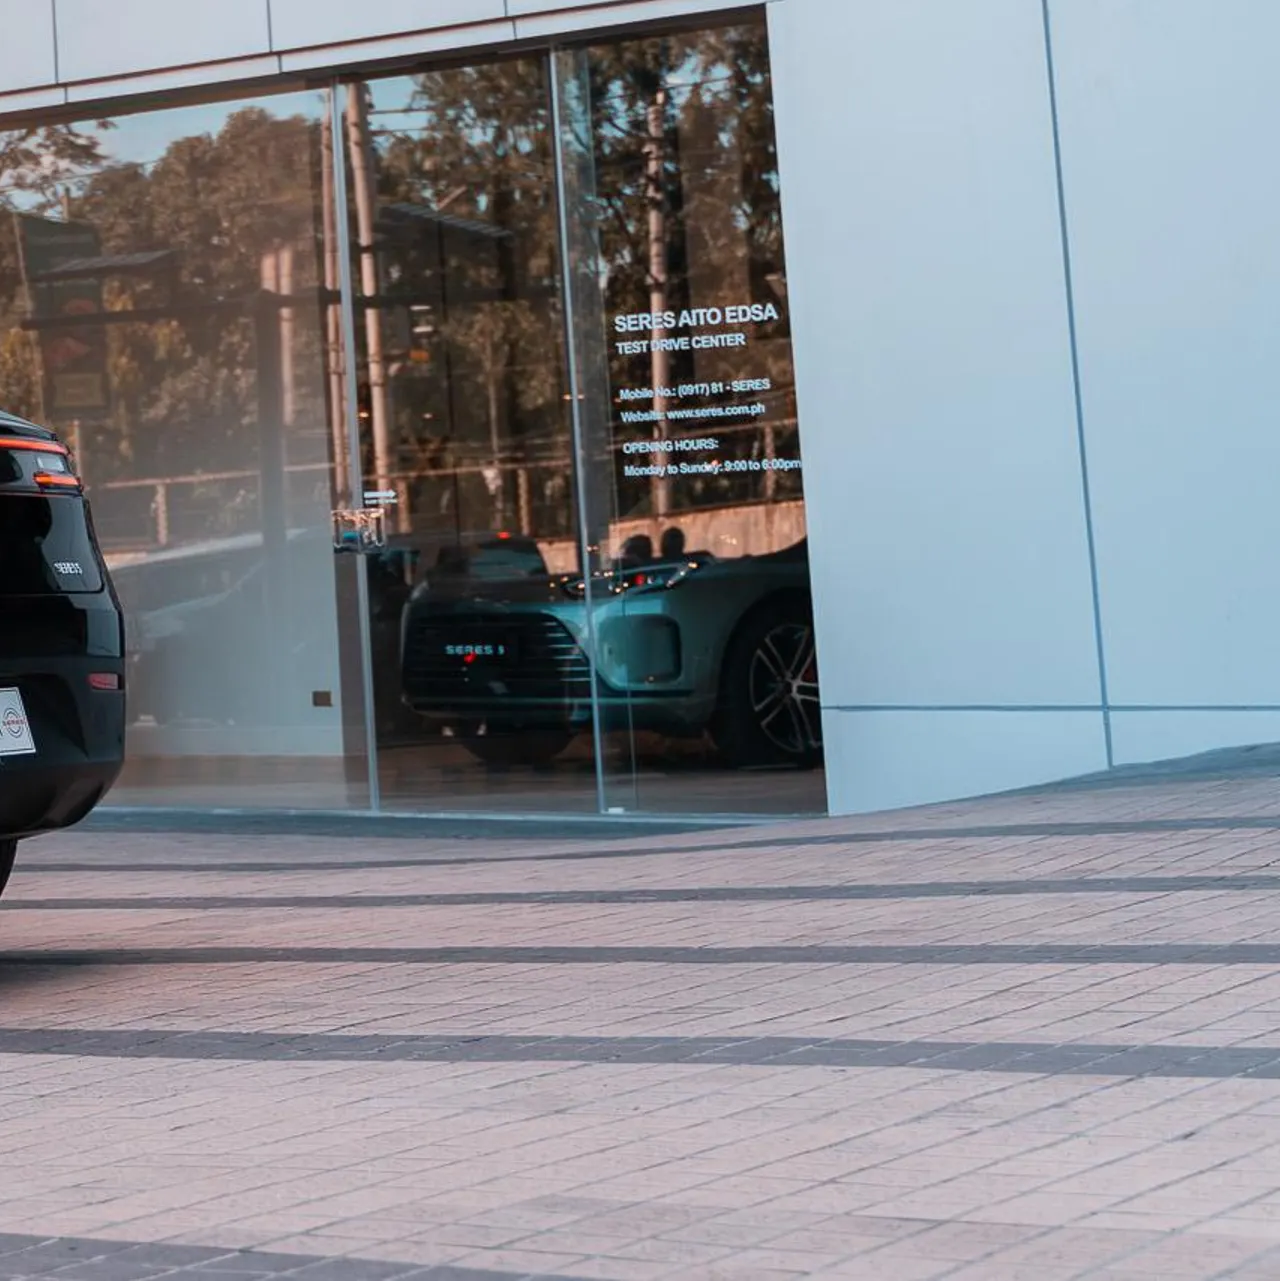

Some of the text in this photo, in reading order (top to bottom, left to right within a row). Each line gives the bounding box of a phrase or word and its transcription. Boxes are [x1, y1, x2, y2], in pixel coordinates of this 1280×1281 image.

[614, 303, 779, 333] SERES AITO EDSA
[615, 332, 746, 355] TEST DRIVE CENTER
[619, 386, 653, 400] Mobile
[655, 385, 676, 398] No.:
[678, 382, 710, 398] (0917)
[711, 382, 724, 394] 81
[732, 378, 771, 391] SERES
[667, 402, 766, 420] www.seres.com.ph
[623, 437, 719, 454] OPENING HOURS:
[624, 463, 666, 478] Monday
[667, 464, 678, 475] to
[724, 459, 748, 472] 9:00
[748, 459, 760, 471] to
